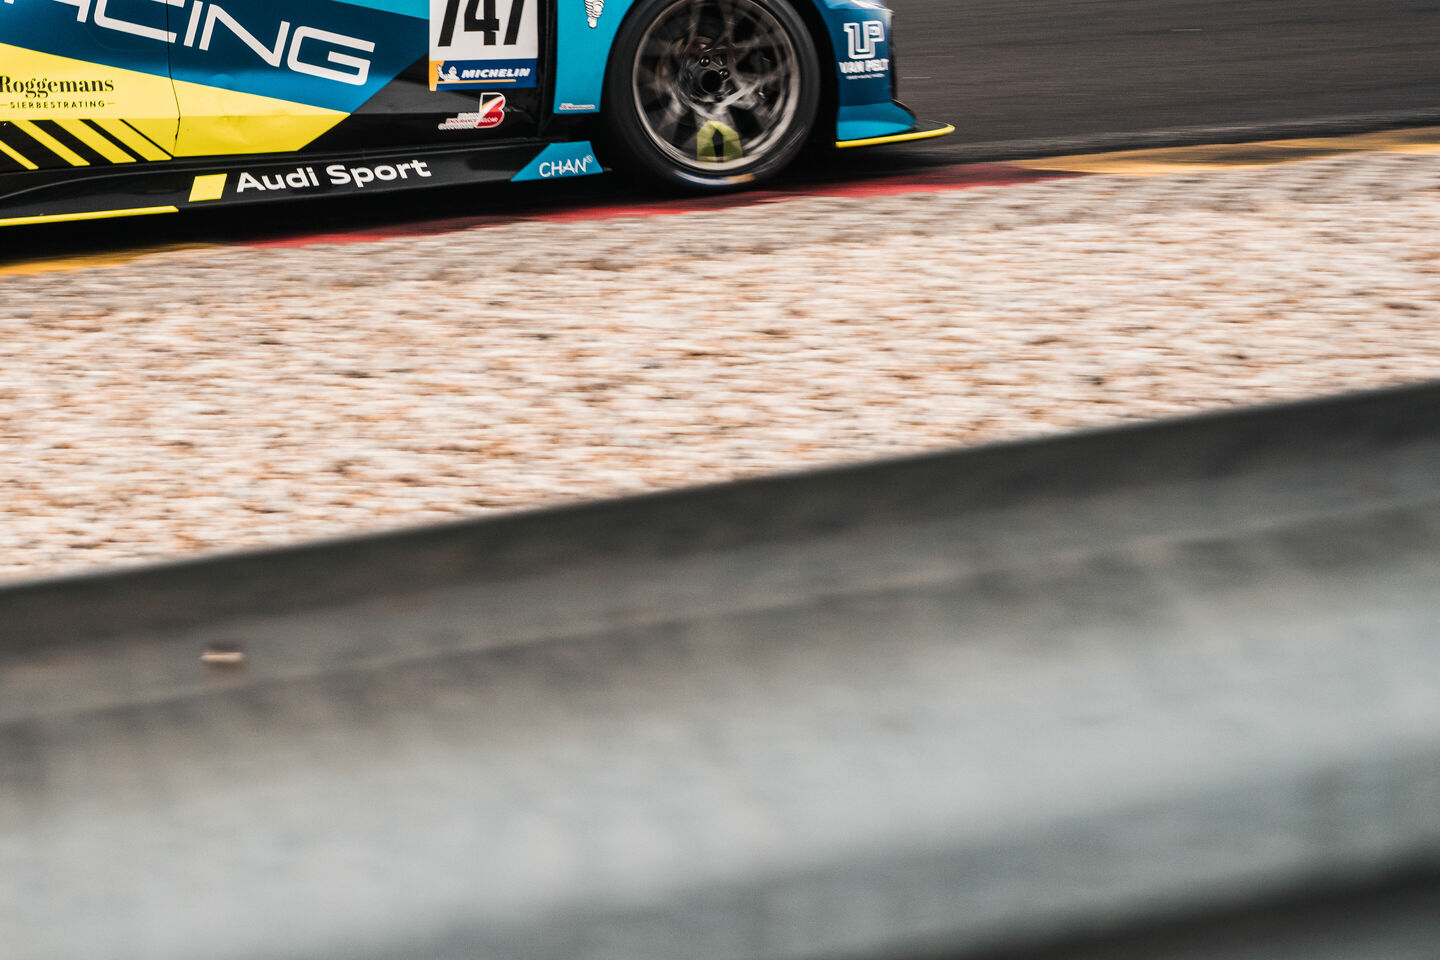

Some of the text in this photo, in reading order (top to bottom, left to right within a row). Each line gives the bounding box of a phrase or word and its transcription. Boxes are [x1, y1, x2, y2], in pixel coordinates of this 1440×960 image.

[461, 67, 531, 79] MICHELIN
[10, 100, 105, 109] SIERBESTRATING
[236, 159, 432, 193] Audi Sport
